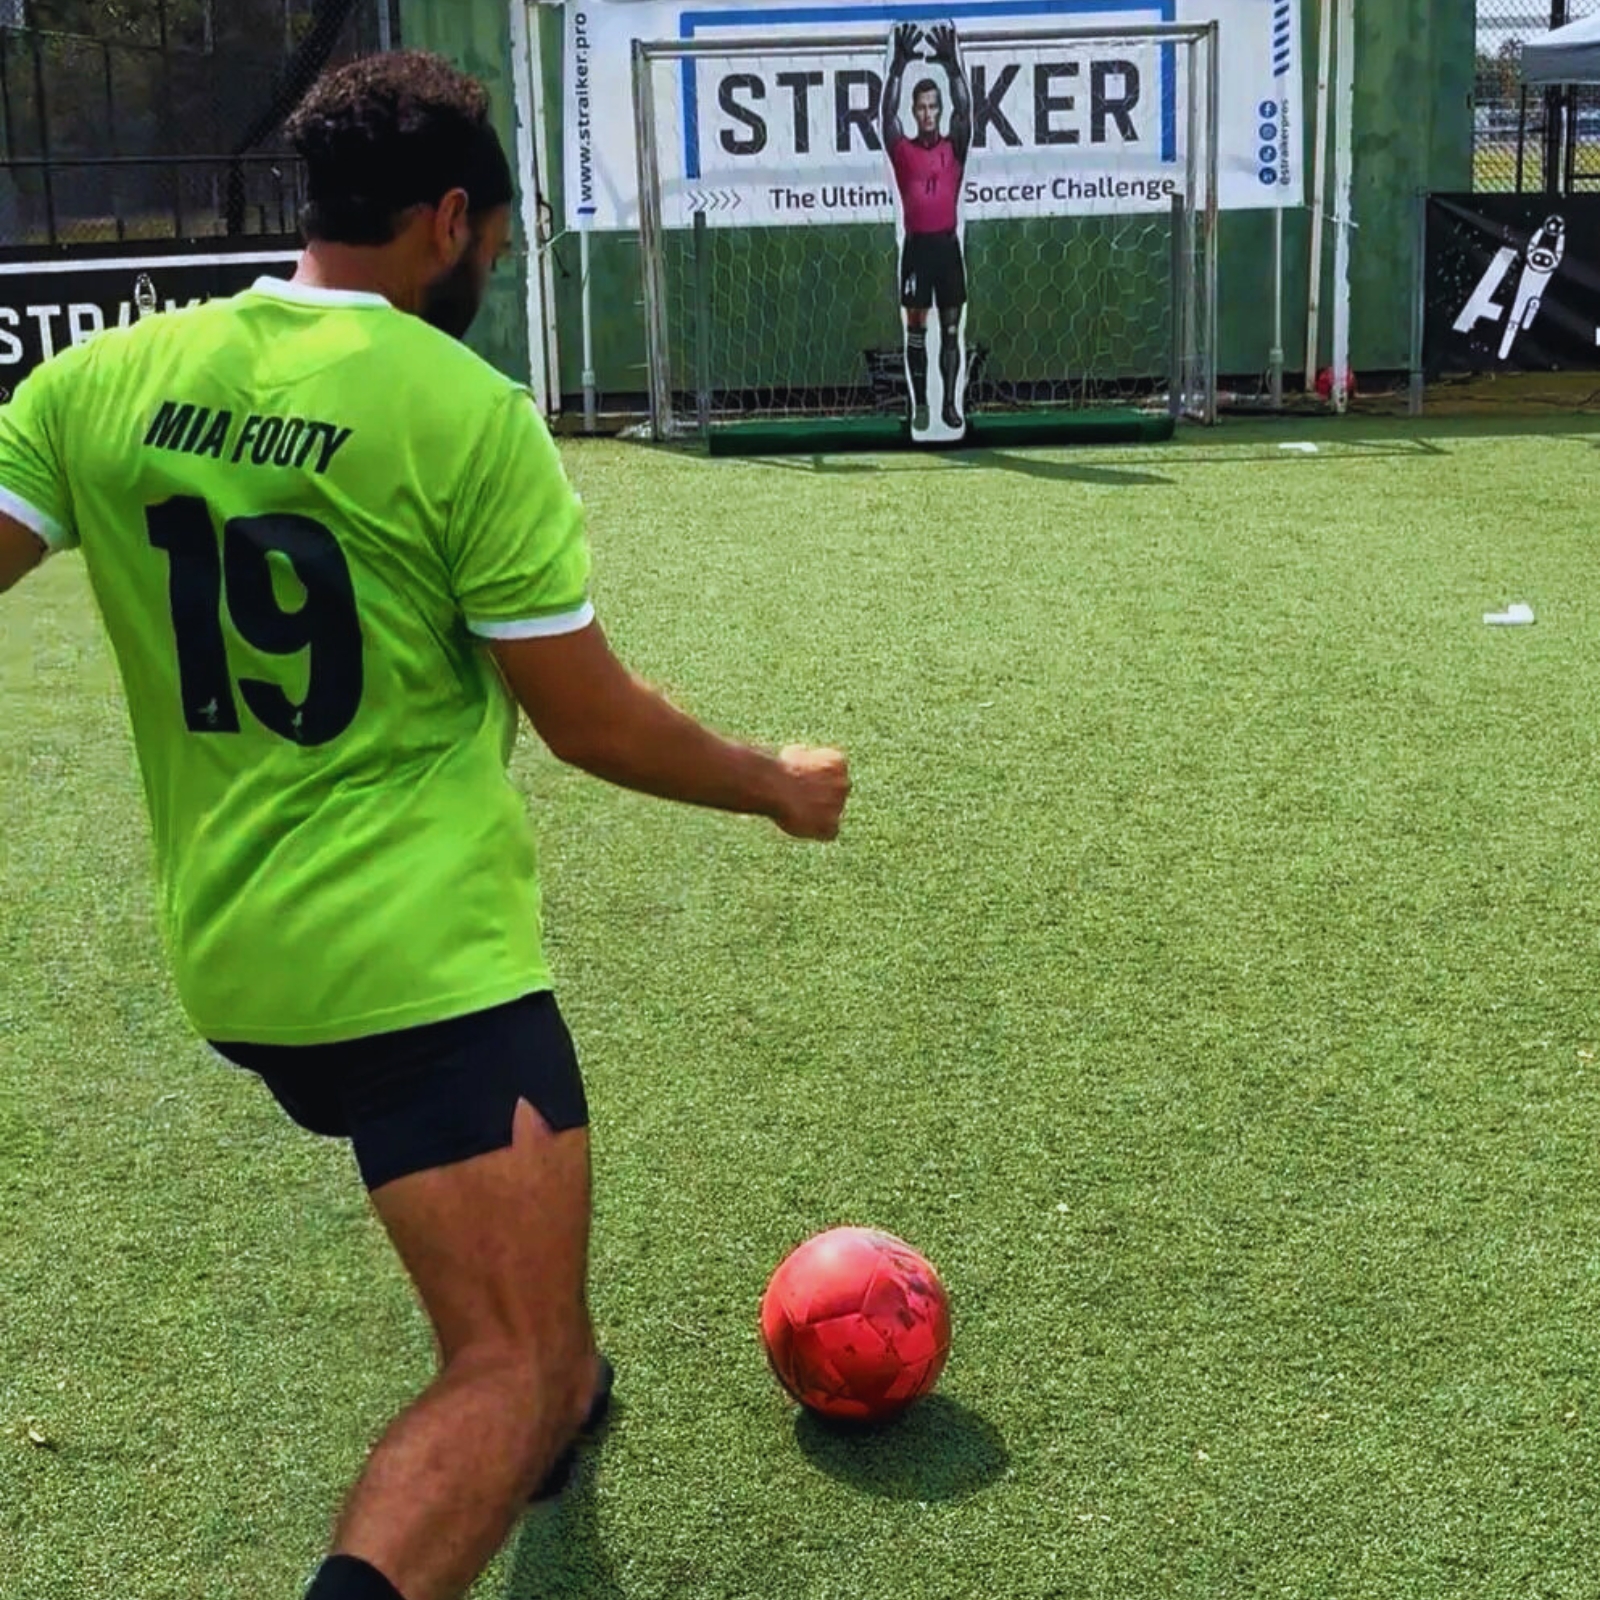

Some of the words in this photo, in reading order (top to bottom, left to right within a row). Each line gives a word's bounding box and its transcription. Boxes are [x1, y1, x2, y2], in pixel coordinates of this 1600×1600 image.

[574, 12, 593, 202] www.straiker.pro
[769, 188, 815, 209] The
[821, 186, 893, 208] Ultim
[964, 182, 1046, 203] Soccer
[1051, 177, 1176, 201] Challenge
[144, 401, 232, 459] MIA
[231, 415, 353, 474] FOOTY
[145, 494, 363, 746] 19
